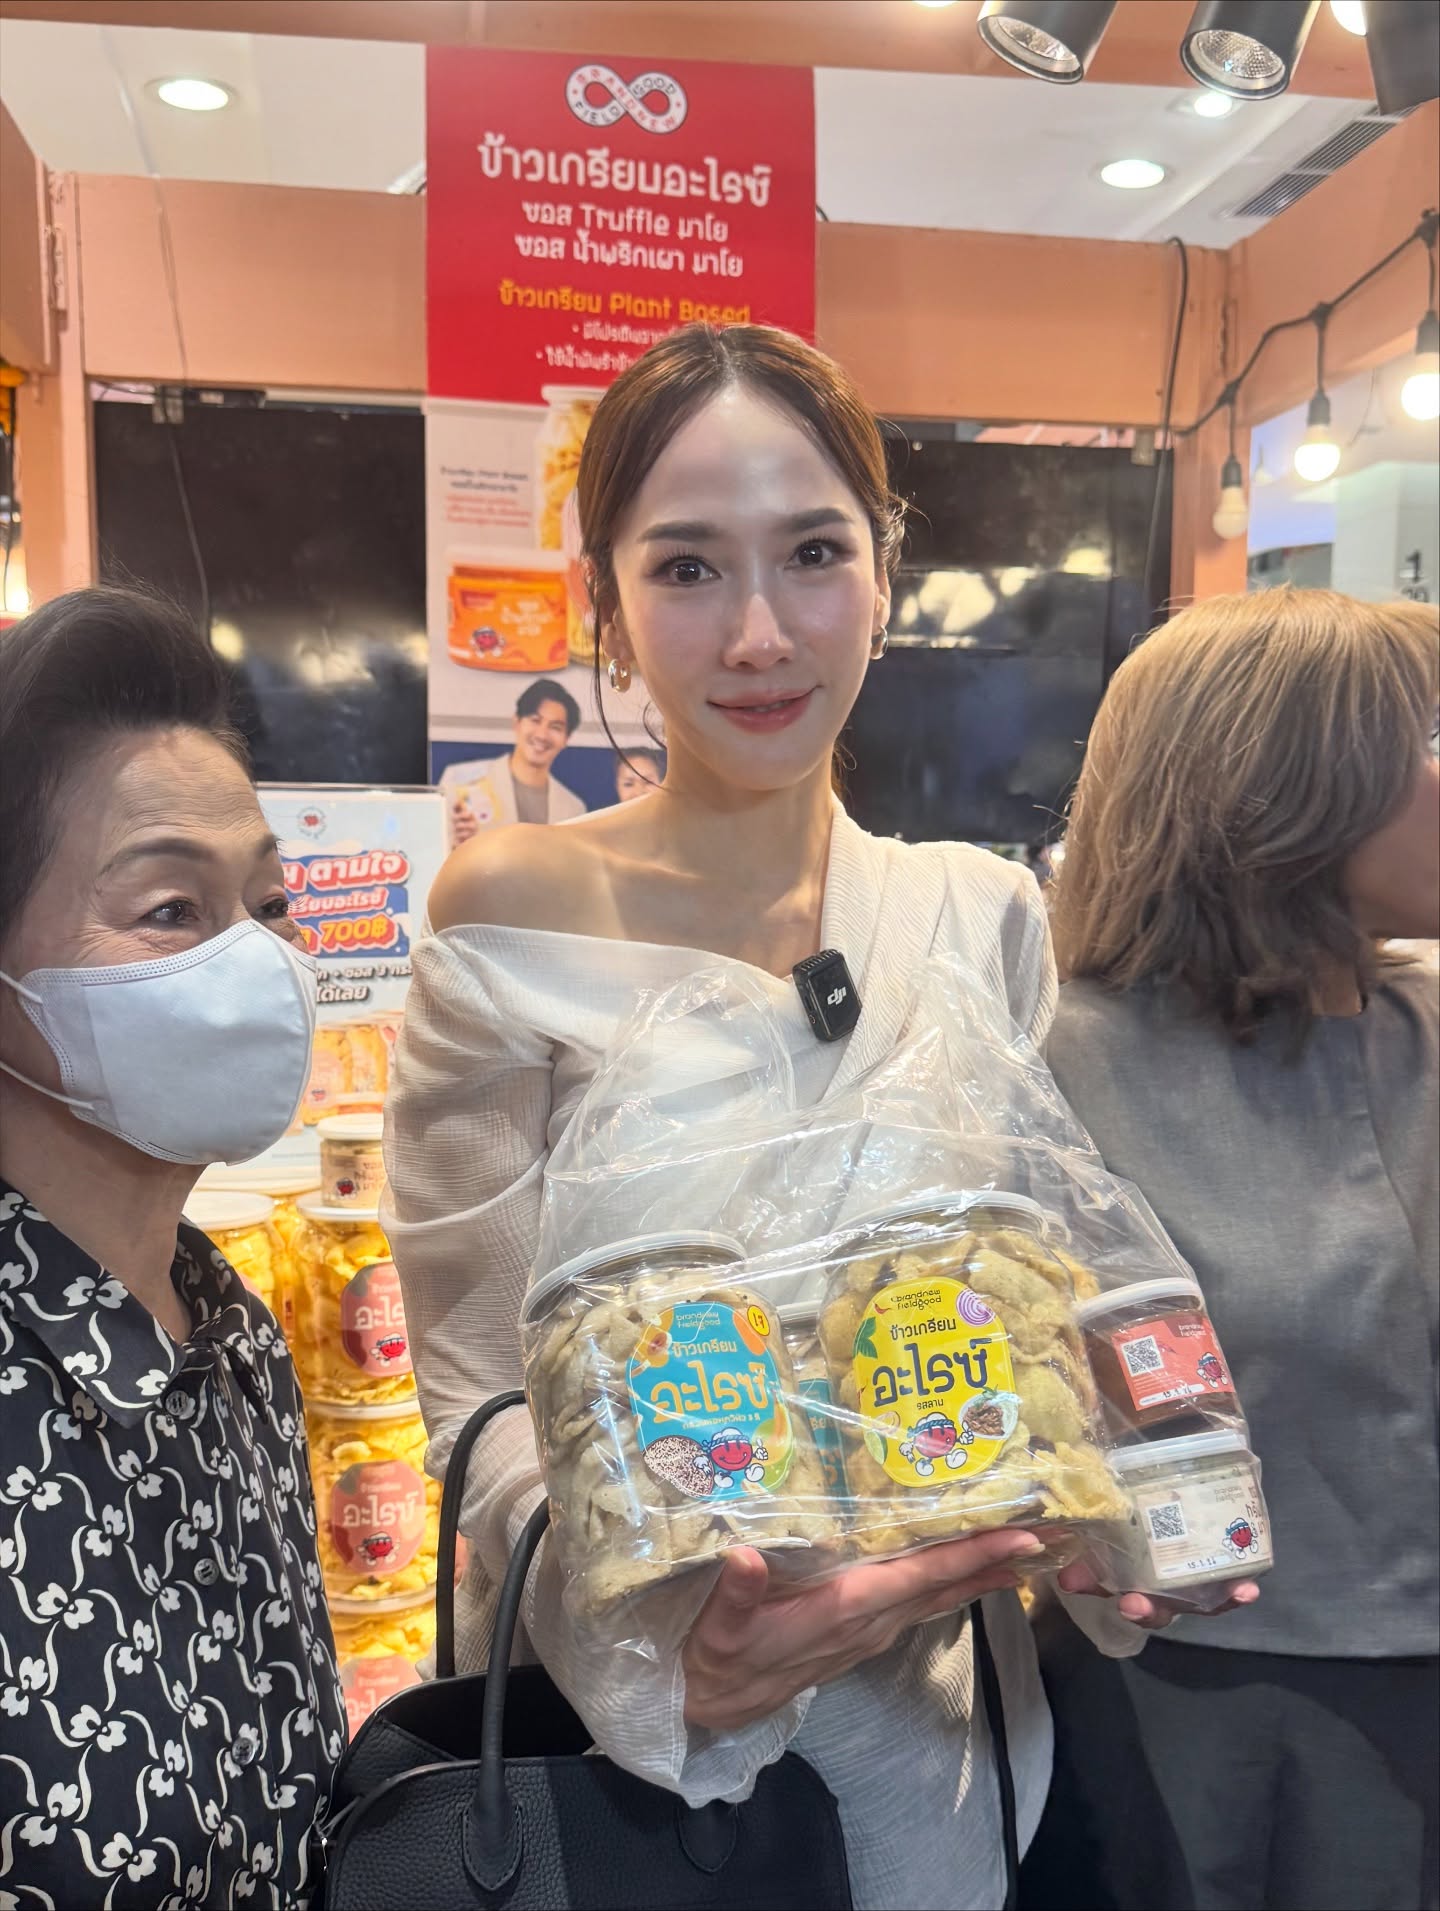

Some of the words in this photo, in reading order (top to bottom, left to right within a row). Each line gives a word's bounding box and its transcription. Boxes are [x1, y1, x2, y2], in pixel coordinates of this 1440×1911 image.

[521, 200, 573, 226] ซอส
[579, 203, 671, 236] Truffle
[677, 212, 729, 243] มาโย
[514, 234, 566, 260] ซอส
[573, 229, 685, 271] น้ำพริกเผา
[691, 247, 743, 278] มาโย
[499, 279, 602, 313] ข้าวเกรียบ
[610, 292, 673, 320] Plant
[309, 850, 404, 883] ตามใจ
[320, 916, 389, 944] 700฿
[355, 1296, 406, 1331] อะไร
[890, 1318, 957, 1341] ข้าวเกรียบ
[672, 1339, 737, 1358] ข้าวเกรียบ
[651, 1360, 769, 1423] อะไรซ์
[872, 1338, 992, 1408] อะไรซ์
[342, 1490, 419, 1528] อะไรซ์
